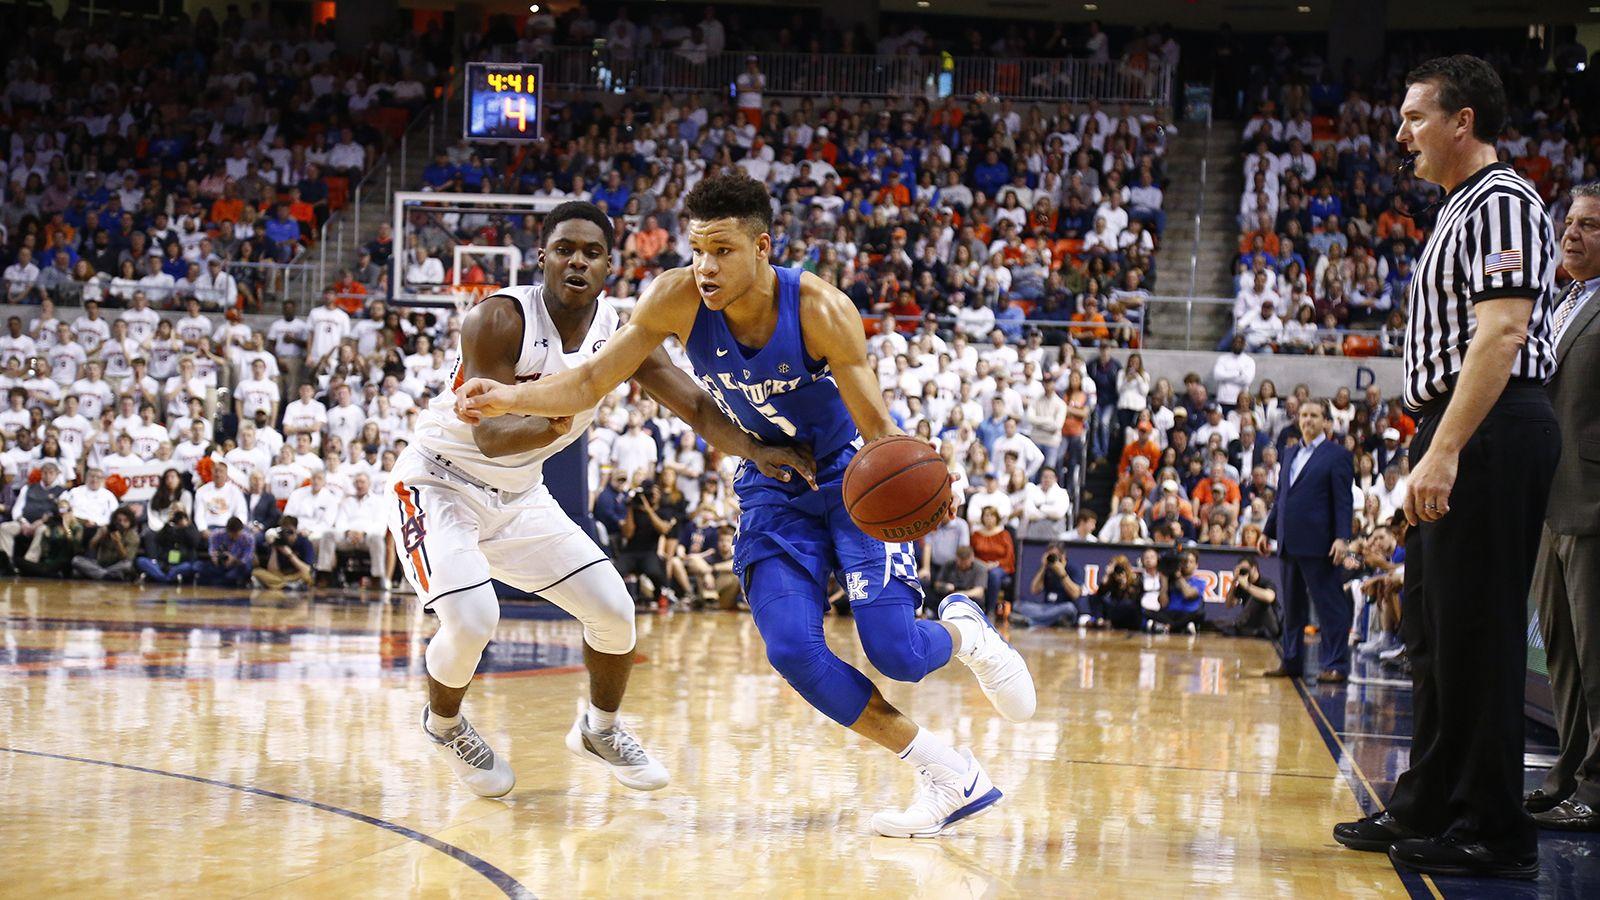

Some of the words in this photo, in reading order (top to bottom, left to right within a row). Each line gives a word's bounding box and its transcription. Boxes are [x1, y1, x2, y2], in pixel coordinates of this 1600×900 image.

[487, 73, 535, 93] 4:41
[504, 96, 527, 132] 4
[1356, 366, 1376, 391] D
[749, 402, 797, 437] 5
[881, 500, 947, 539] Wilson
